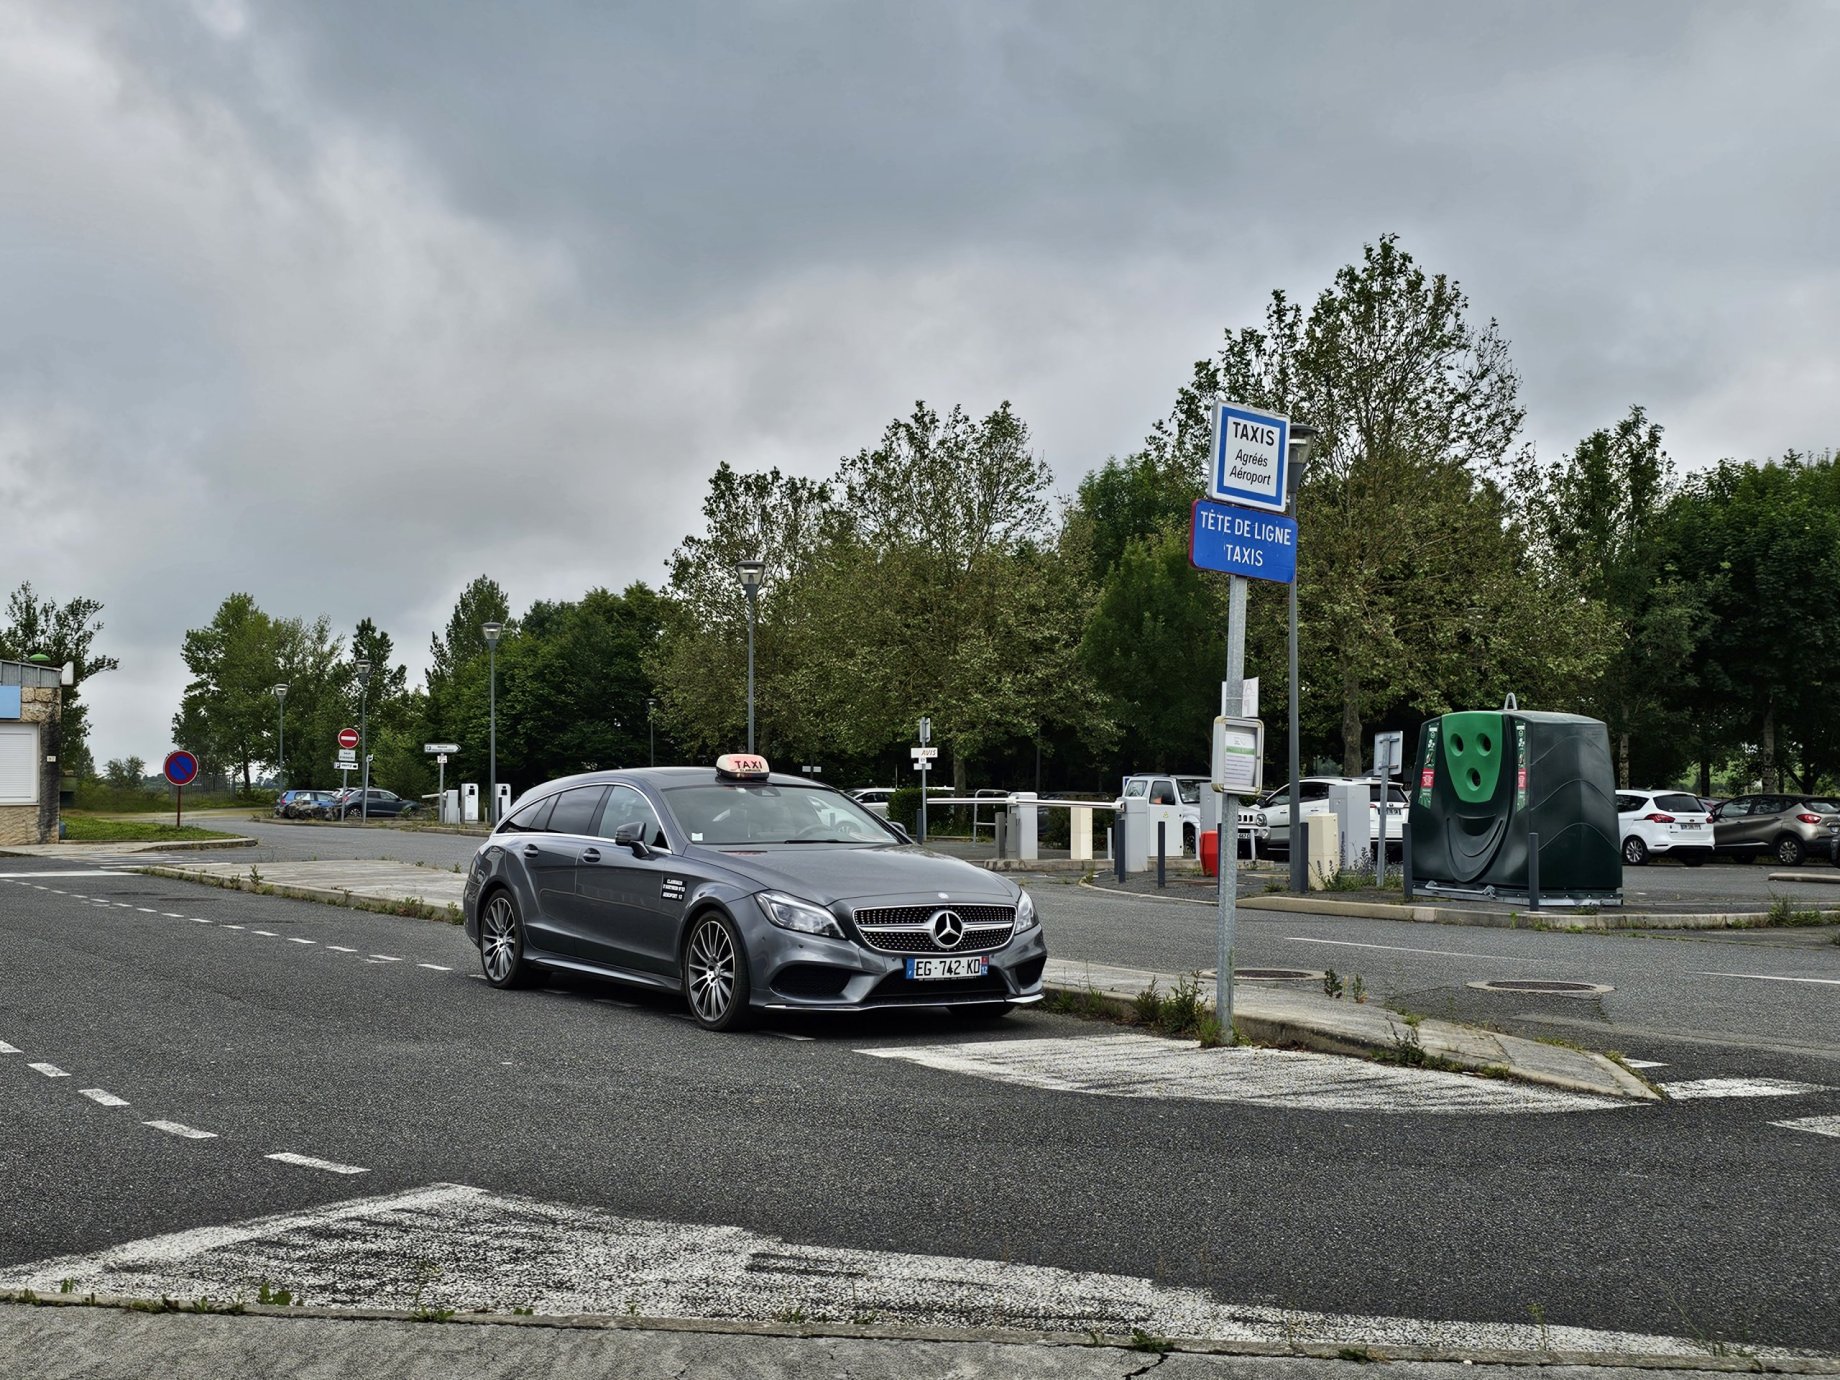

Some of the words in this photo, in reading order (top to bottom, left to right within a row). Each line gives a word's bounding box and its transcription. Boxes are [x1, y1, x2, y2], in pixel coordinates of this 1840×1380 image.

[1233, 421, 1275, 446] TAXIS
[1235, 449, 1268, 467] Agréés
[1229, 465, 1271, 485] Aéroport
[1235, 519, 1251, 537] DE
[1254, 523, 1292, 545] LIGNE
[1226, 544, 1263, 566] TAXIS
[734, 760, 763, 769] TAXI
[915, 959, 981, 977] EG-742-KD
